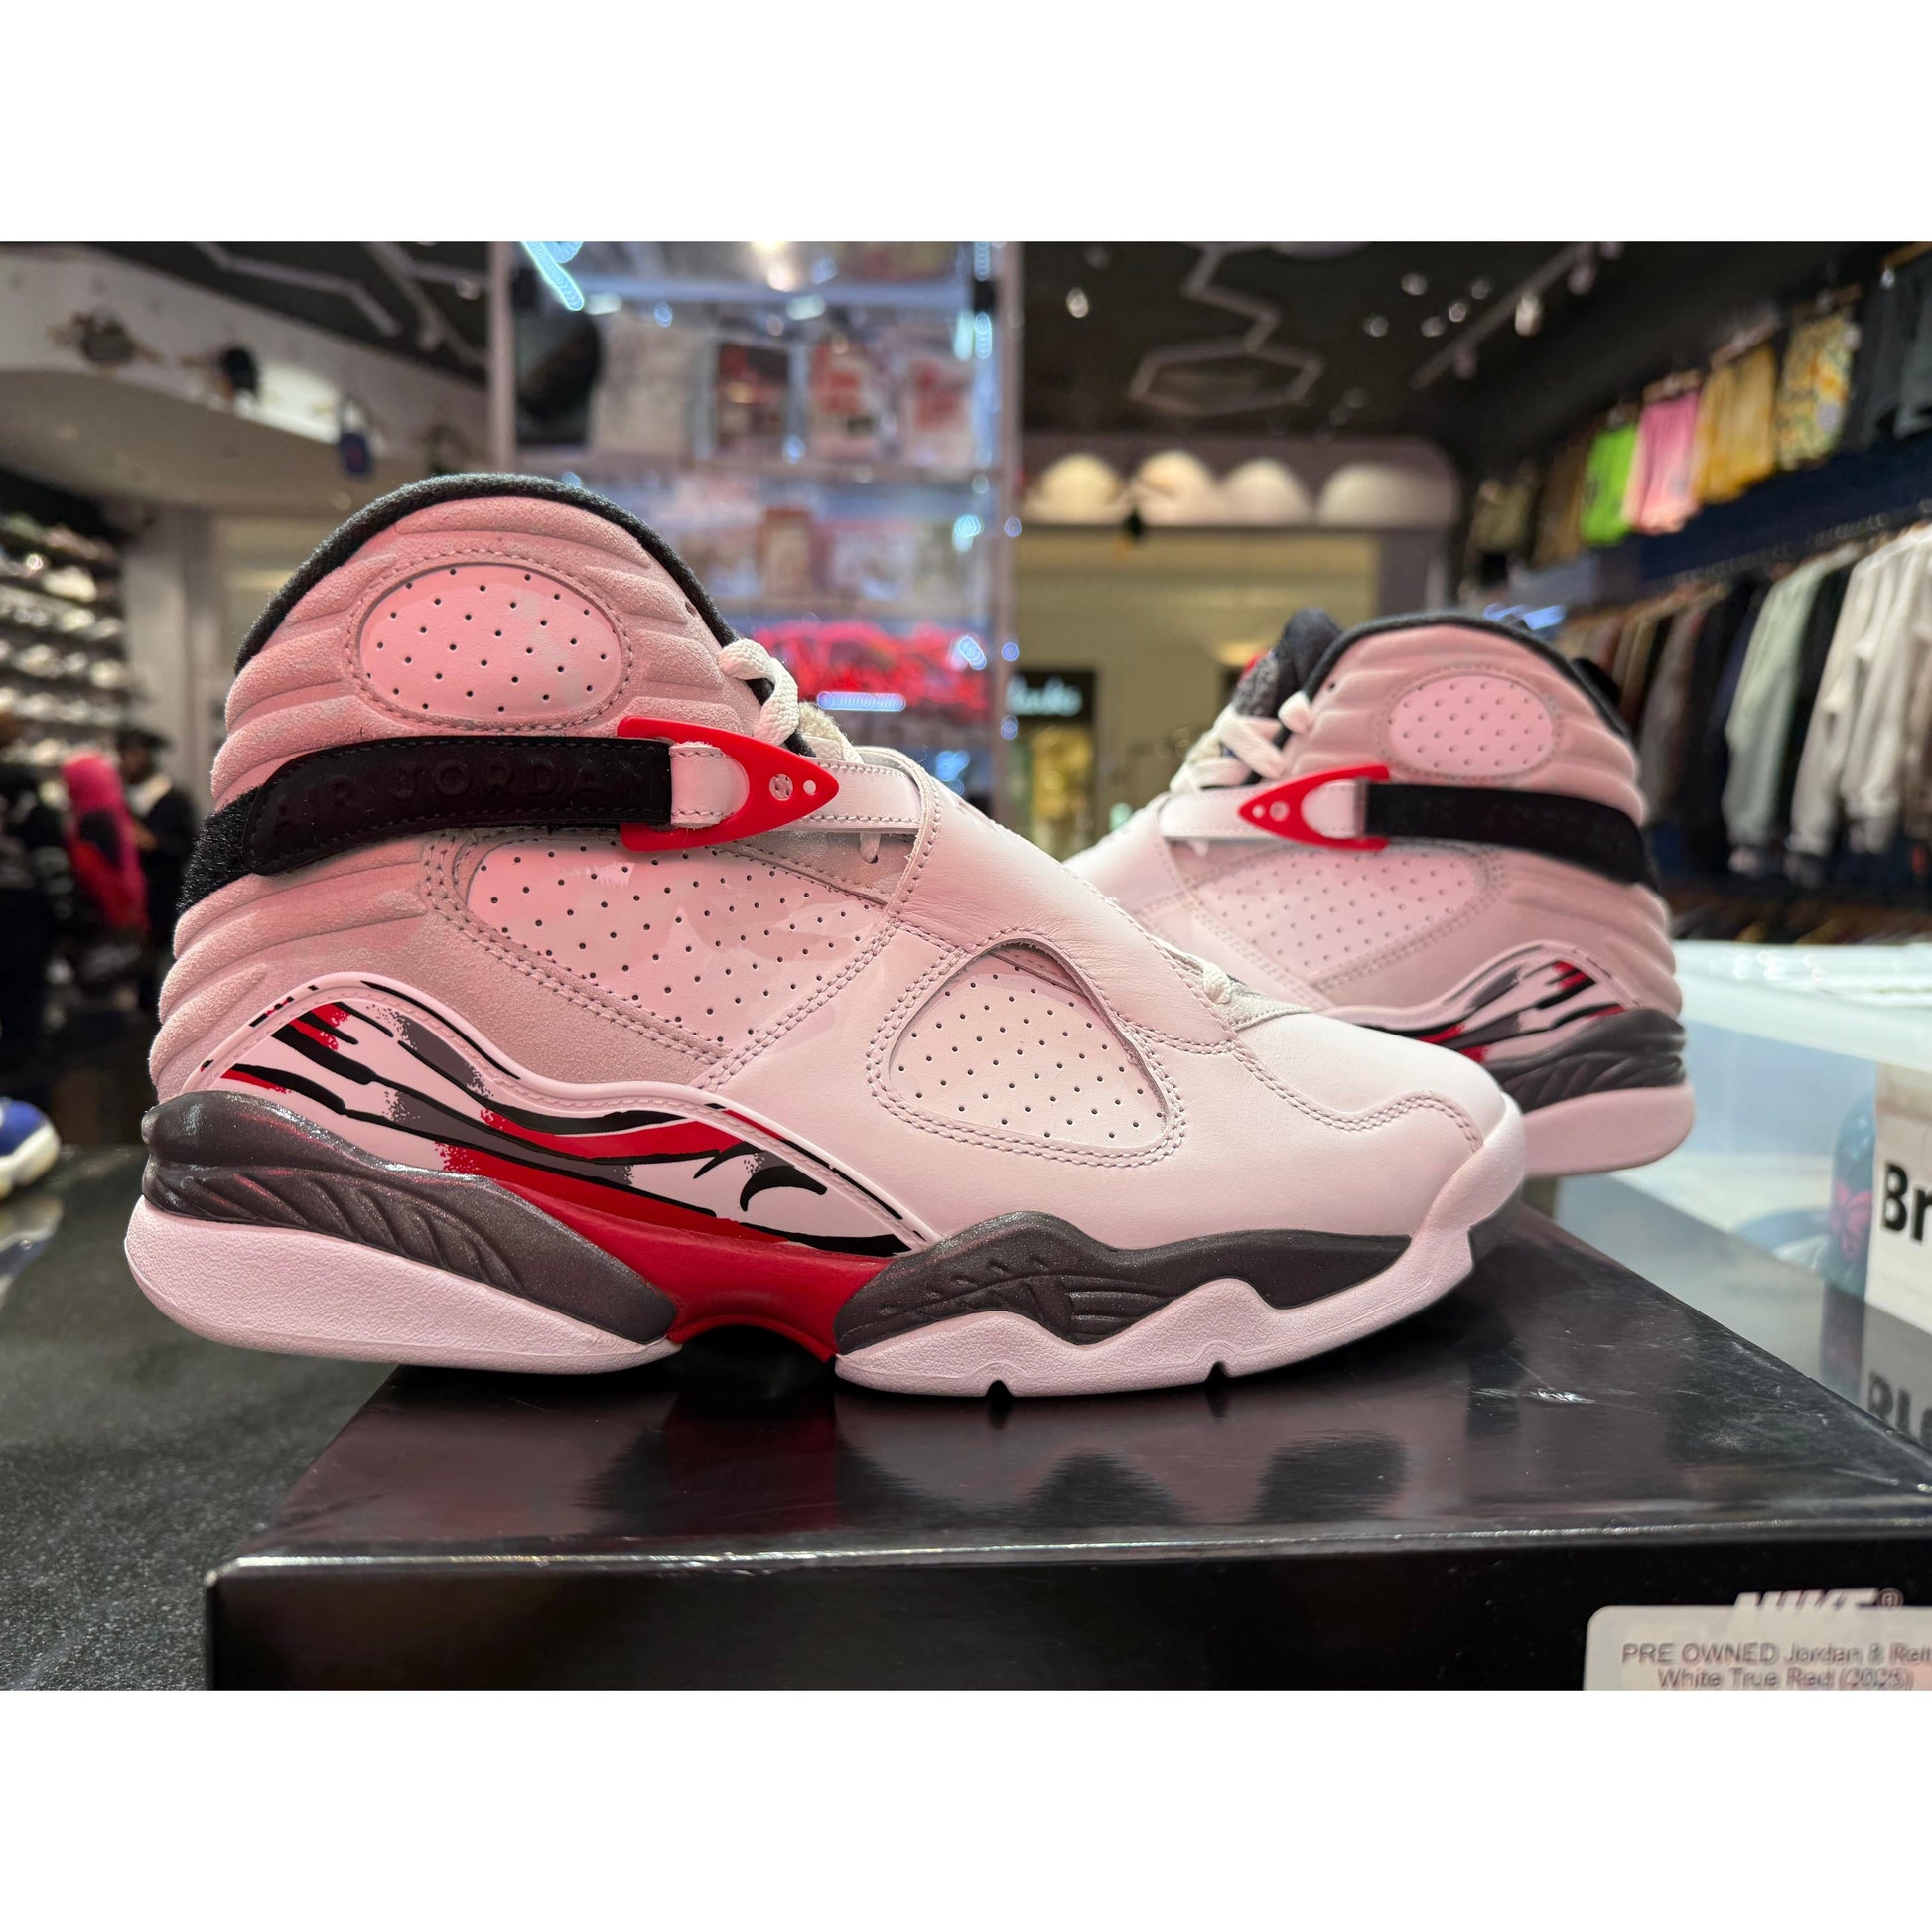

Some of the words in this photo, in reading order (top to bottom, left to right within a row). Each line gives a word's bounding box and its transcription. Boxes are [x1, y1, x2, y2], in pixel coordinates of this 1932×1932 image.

[1622, 1642, 1674, 1663] PRE
[1682, 1642, 1779, 1664] OWNED
[1786, 1642, 1863, 1664] Jordan
[1657, 1667, 1722, 1688] White
[1729, 1667, 1777, 1688] True
[1788, 1667, 1835, 1688] Red
